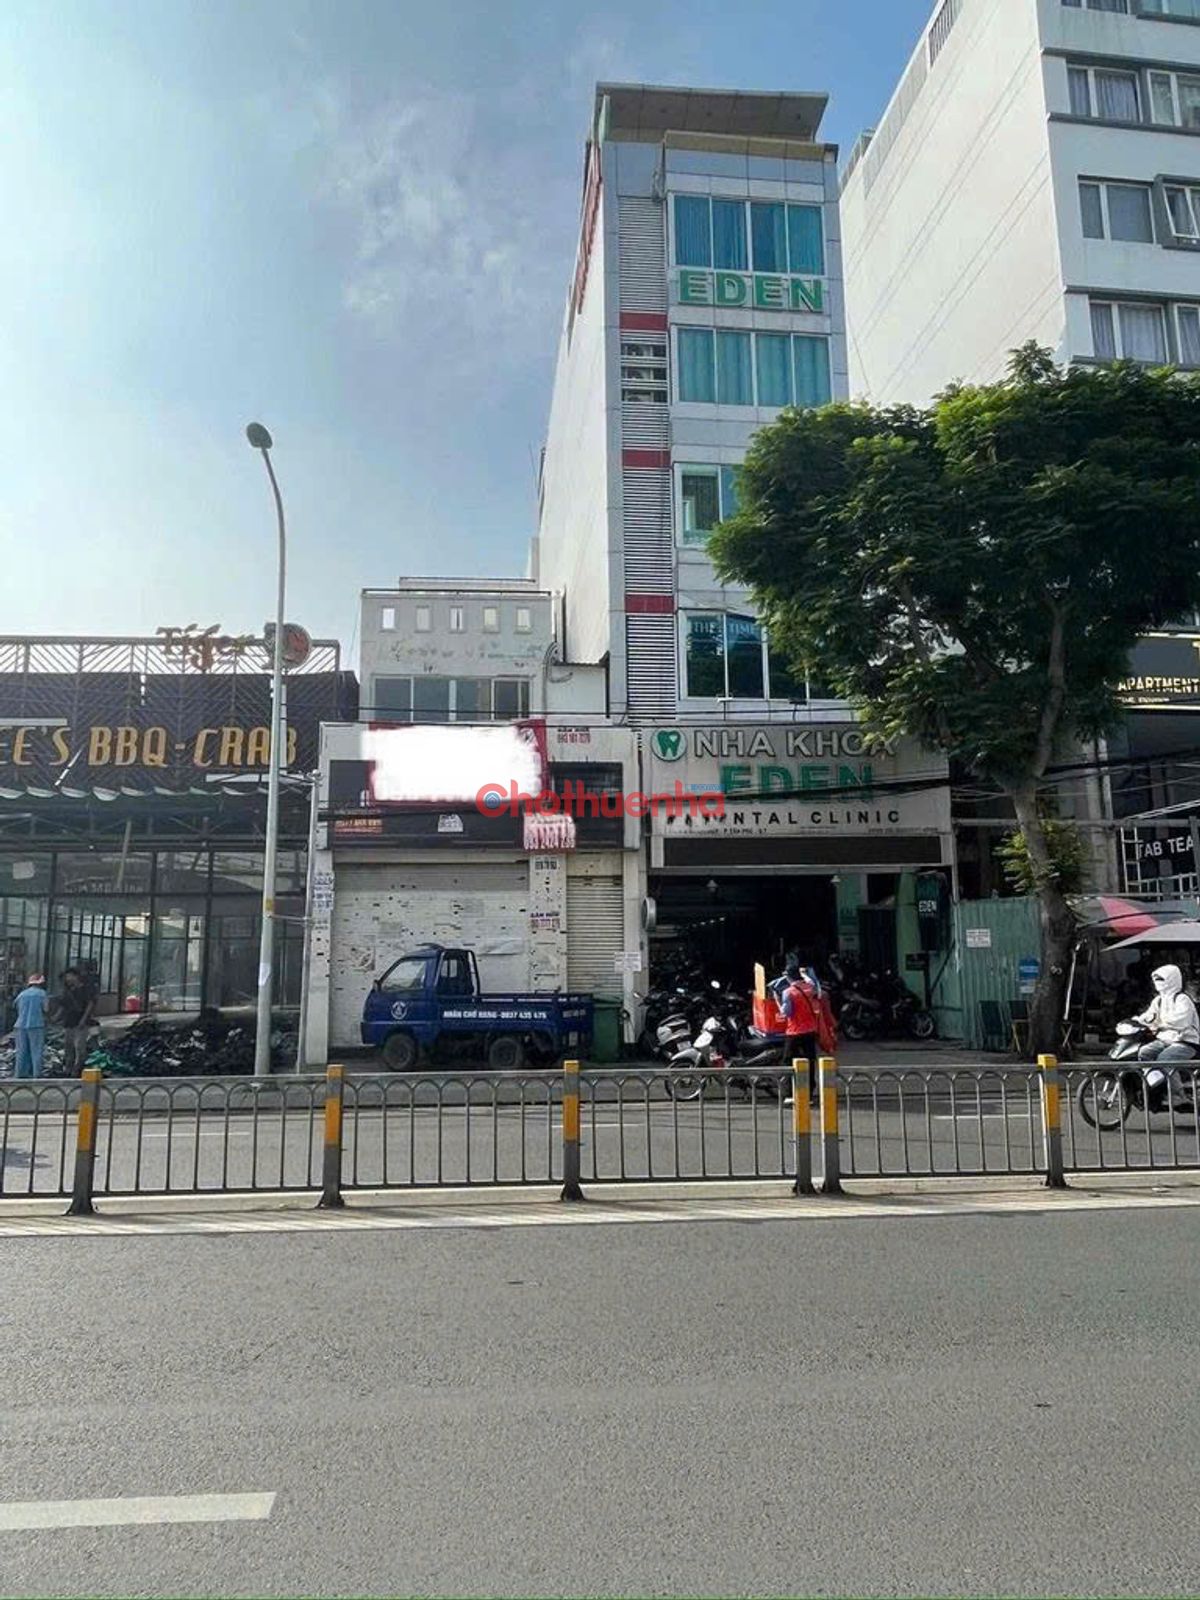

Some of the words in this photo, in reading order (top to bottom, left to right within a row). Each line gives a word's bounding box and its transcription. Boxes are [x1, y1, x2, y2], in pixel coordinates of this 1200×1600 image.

[678, 269, 824, 314] EDEN
[87, 725, 168, 768] BBQ
[694, 730, 776, 758] NHA
[786, 730, 897, 758] KHOA
[720, 763, 875, 804] EDEN
[810, 809, 901, 825] CLINIC
